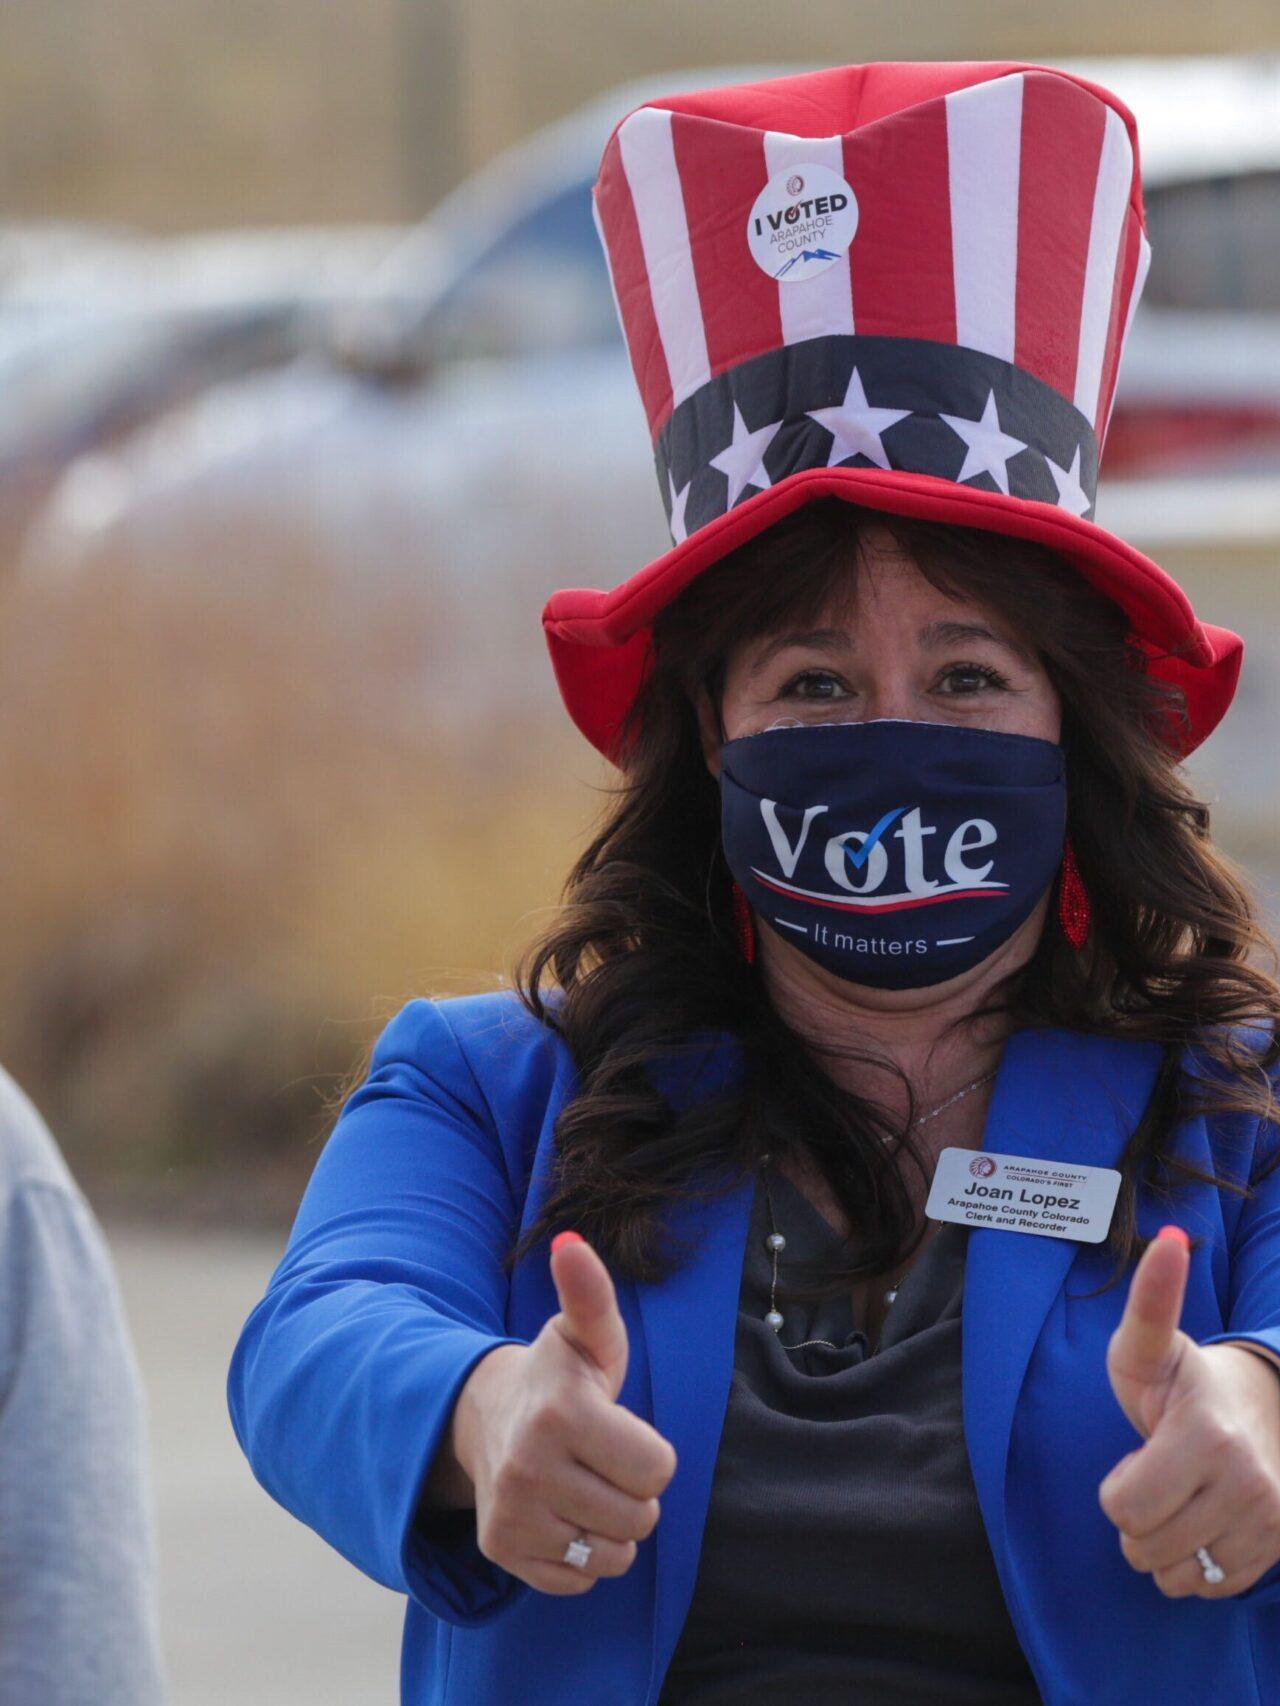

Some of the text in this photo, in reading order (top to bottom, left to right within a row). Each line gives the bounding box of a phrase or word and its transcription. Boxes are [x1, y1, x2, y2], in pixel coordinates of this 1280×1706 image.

[755, 193, 848, 236] I VOTED
[769, 215, 833, 244] ARAPAHOE
[777, 229, 827, 254] COUNTY
[760, 798, 998, 893] Vote
[814, 923, 928, 955] It matters
[1004, 1165, 1088, 1181] ARAPAHOE COUNTY
[1006, 1174, 1074, 1189] COLORADO'S FIRST
[964, 1182, 1081, 1210] Joan Lopez
[948, 1197, 1091, 1225] Arapahoe County Colorado
[965, 1211, 1068, 1233] Clerk and Recorder
